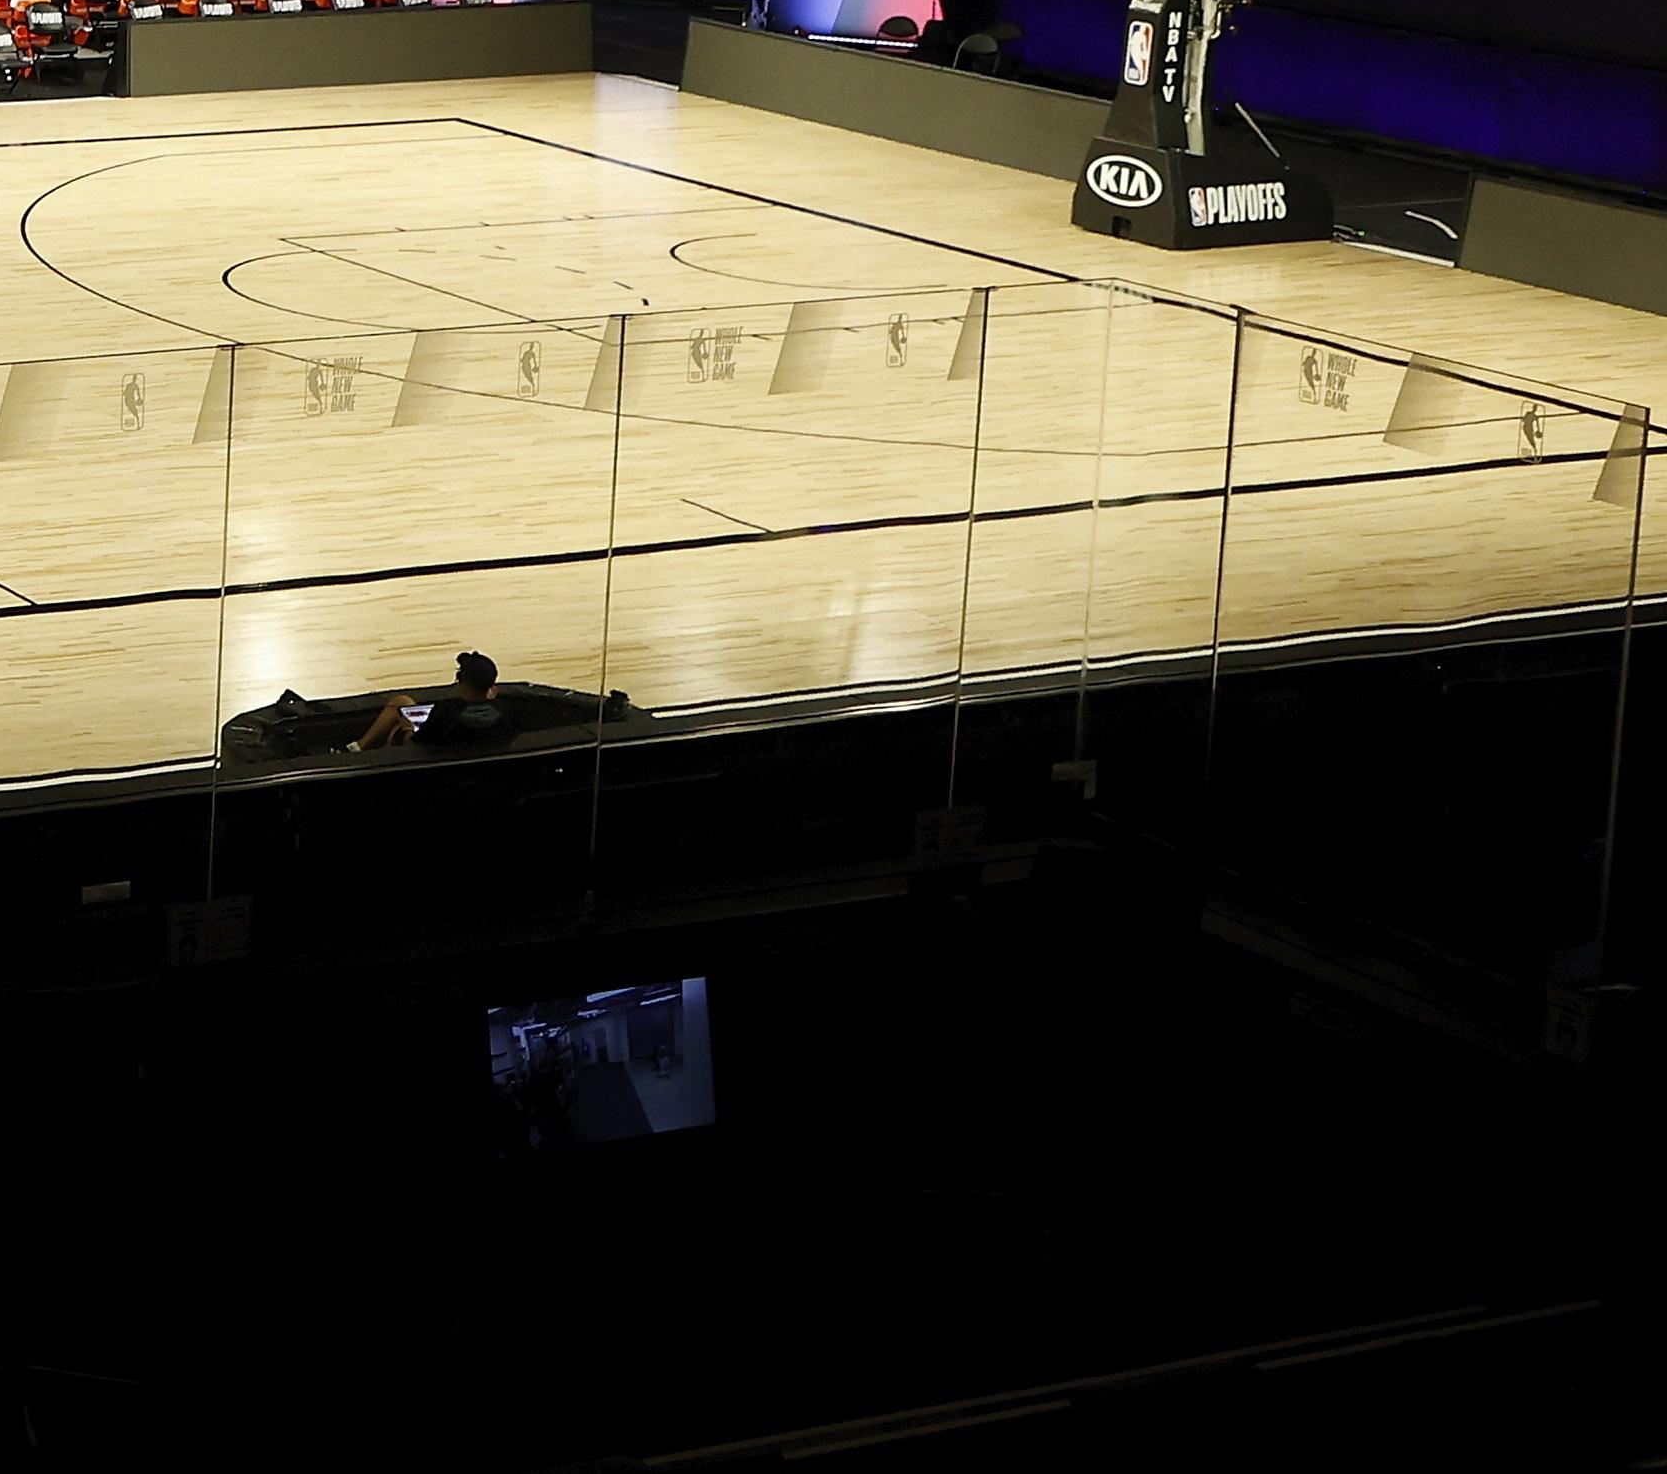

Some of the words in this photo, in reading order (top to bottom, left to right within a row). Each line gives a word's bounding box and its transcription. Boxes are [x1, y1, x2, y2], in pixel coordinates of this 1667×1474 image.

[1165, 11, 1183, 63] NBA
[1100, 163, 1149, 200] KIA
[1205, 182, 1287, 225] PLAYOFFS
